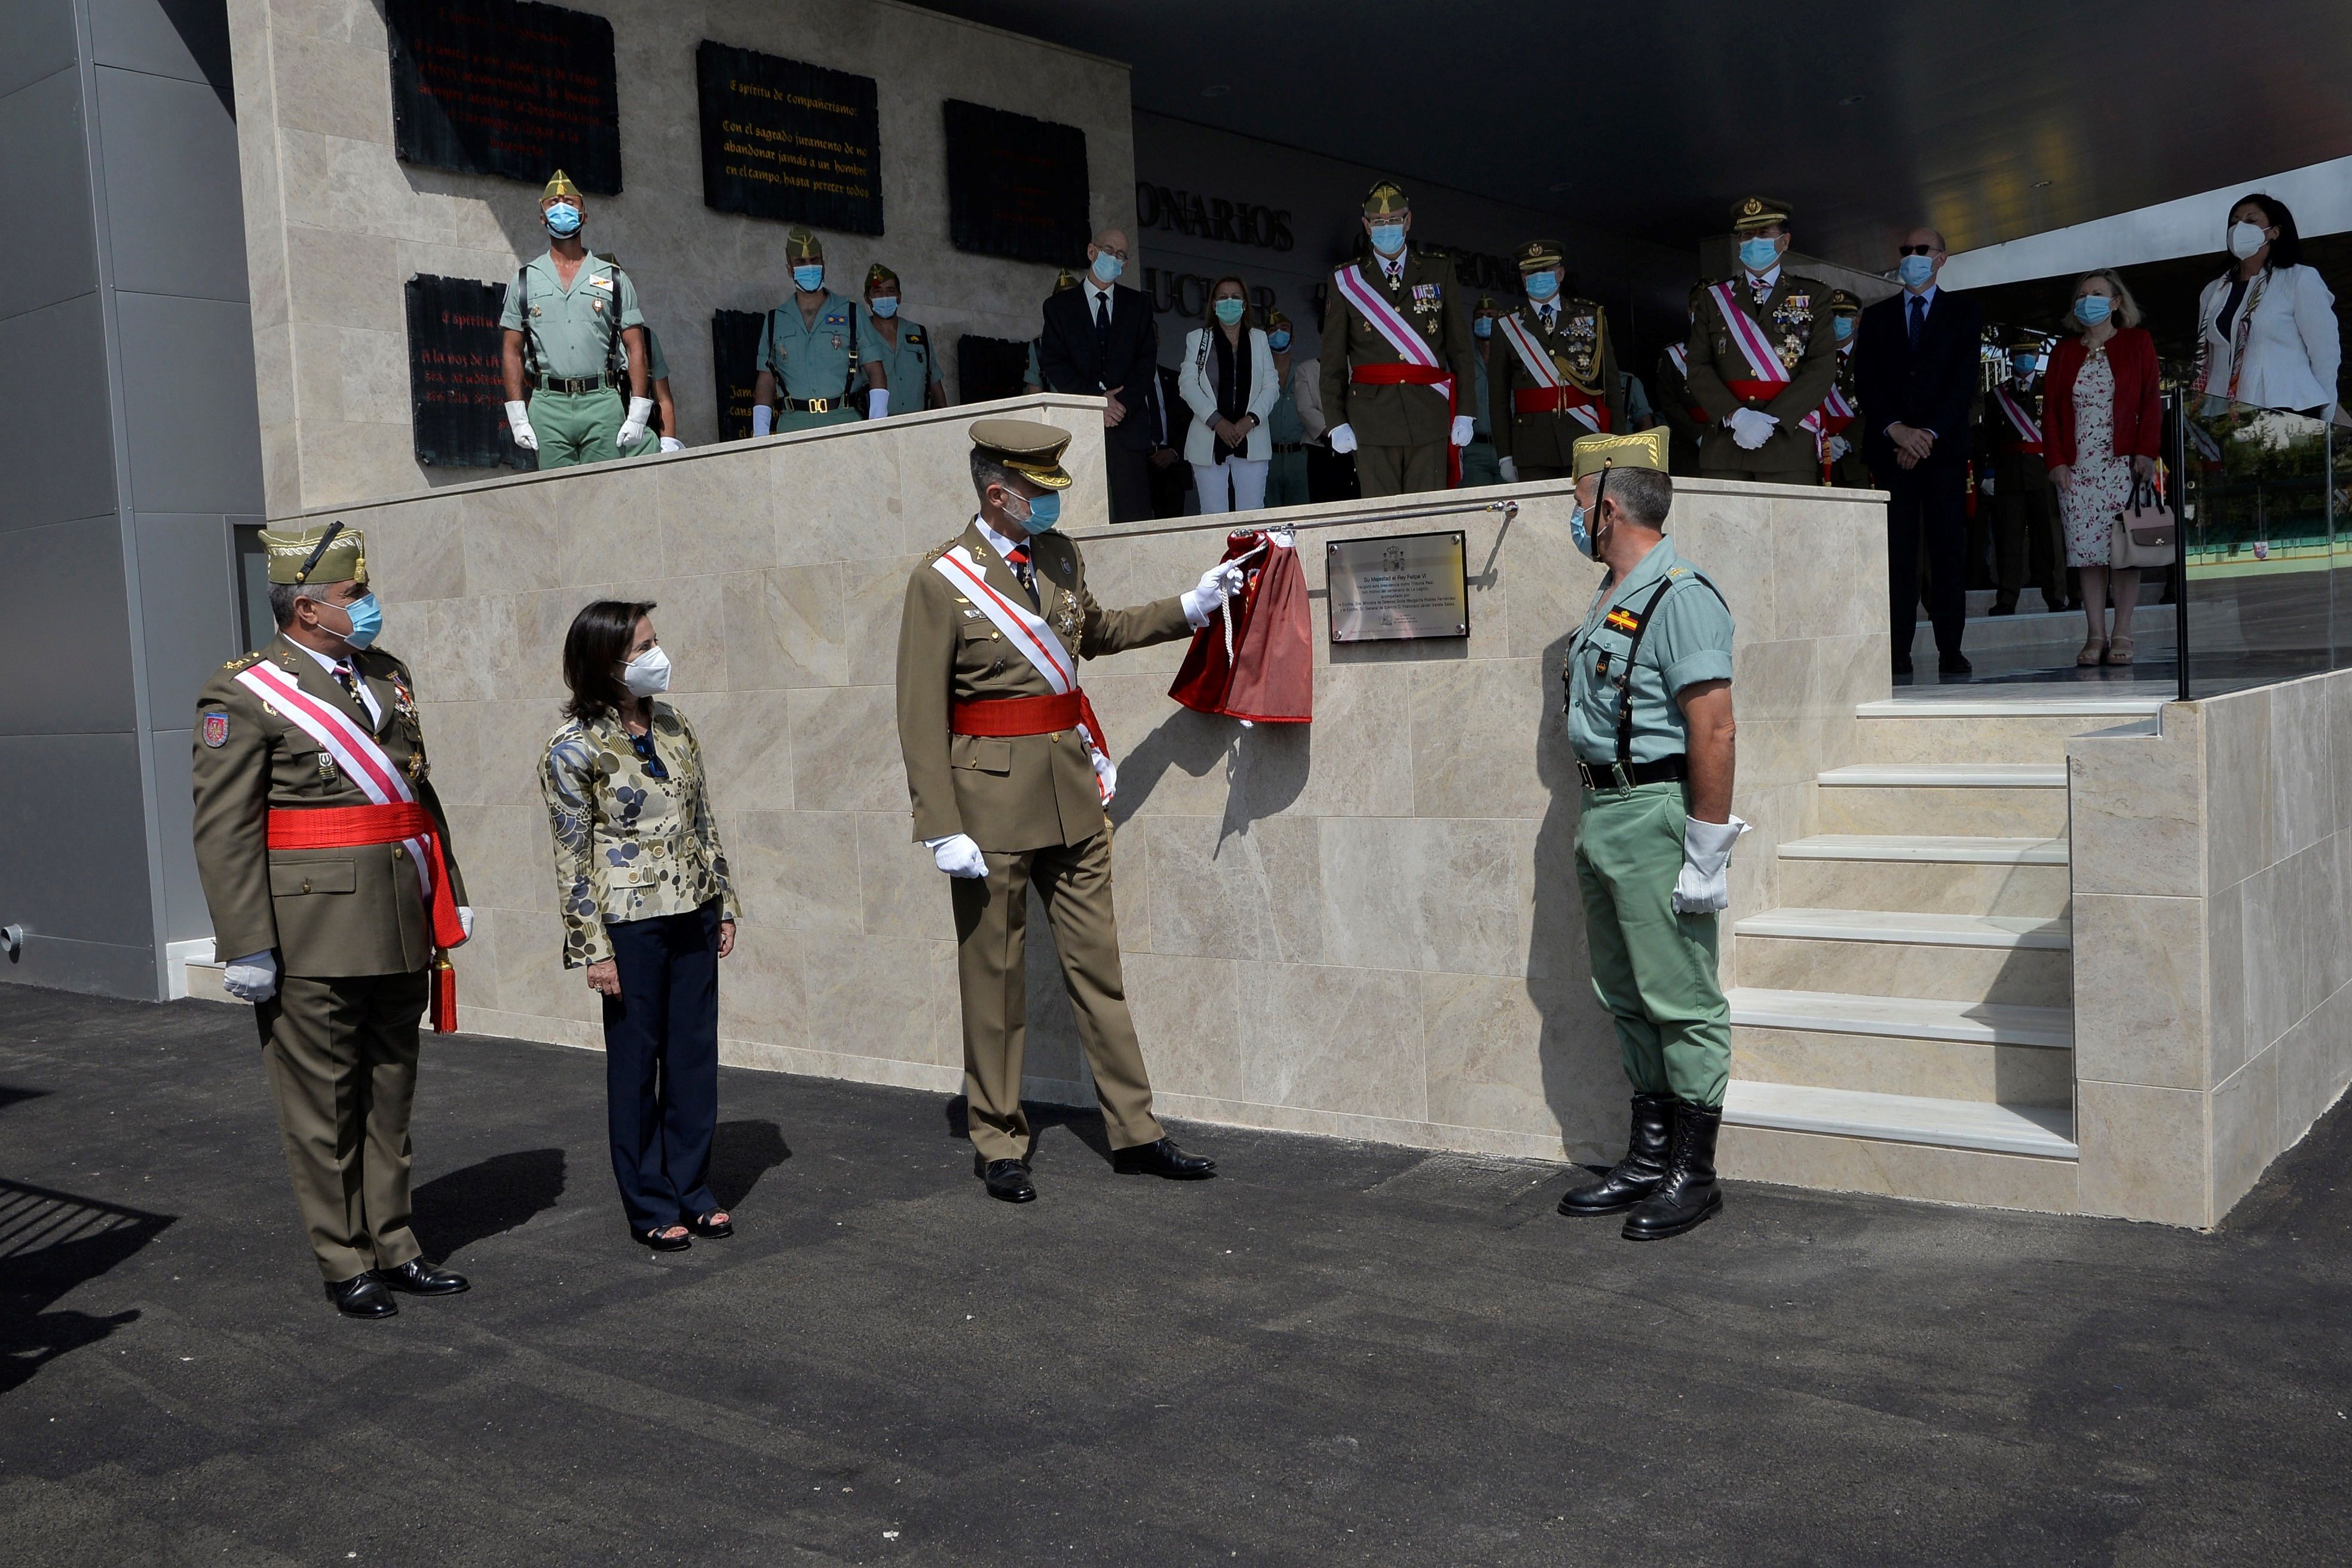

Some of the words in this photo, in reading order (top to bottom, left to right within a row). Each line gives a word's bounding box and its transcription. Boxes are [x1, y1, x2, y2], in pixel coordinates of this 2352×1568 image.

[774, 88, 784, 101] de
[722, 120, 743, 133] Con
[745, 122, 754, 135] el
[755, 127, 793, 143] sagrado
[795, 132, 842, 153] juramento
[844, 141, 855, 154] de
[856, 147, 868, 157] no
[724, 139, 776, 160] abandonar
[777, 150, 807, 167] jamás
[810, 159, 816, 168] a
[818, 160, 830, 170] un
[834, 159, 868, 176] hombre
[726, 165, 737, 175] en
[739, 165, 748, 177] el
[783, 172, 810, 188] hasta
[813, 180, 844, 195] perecer
